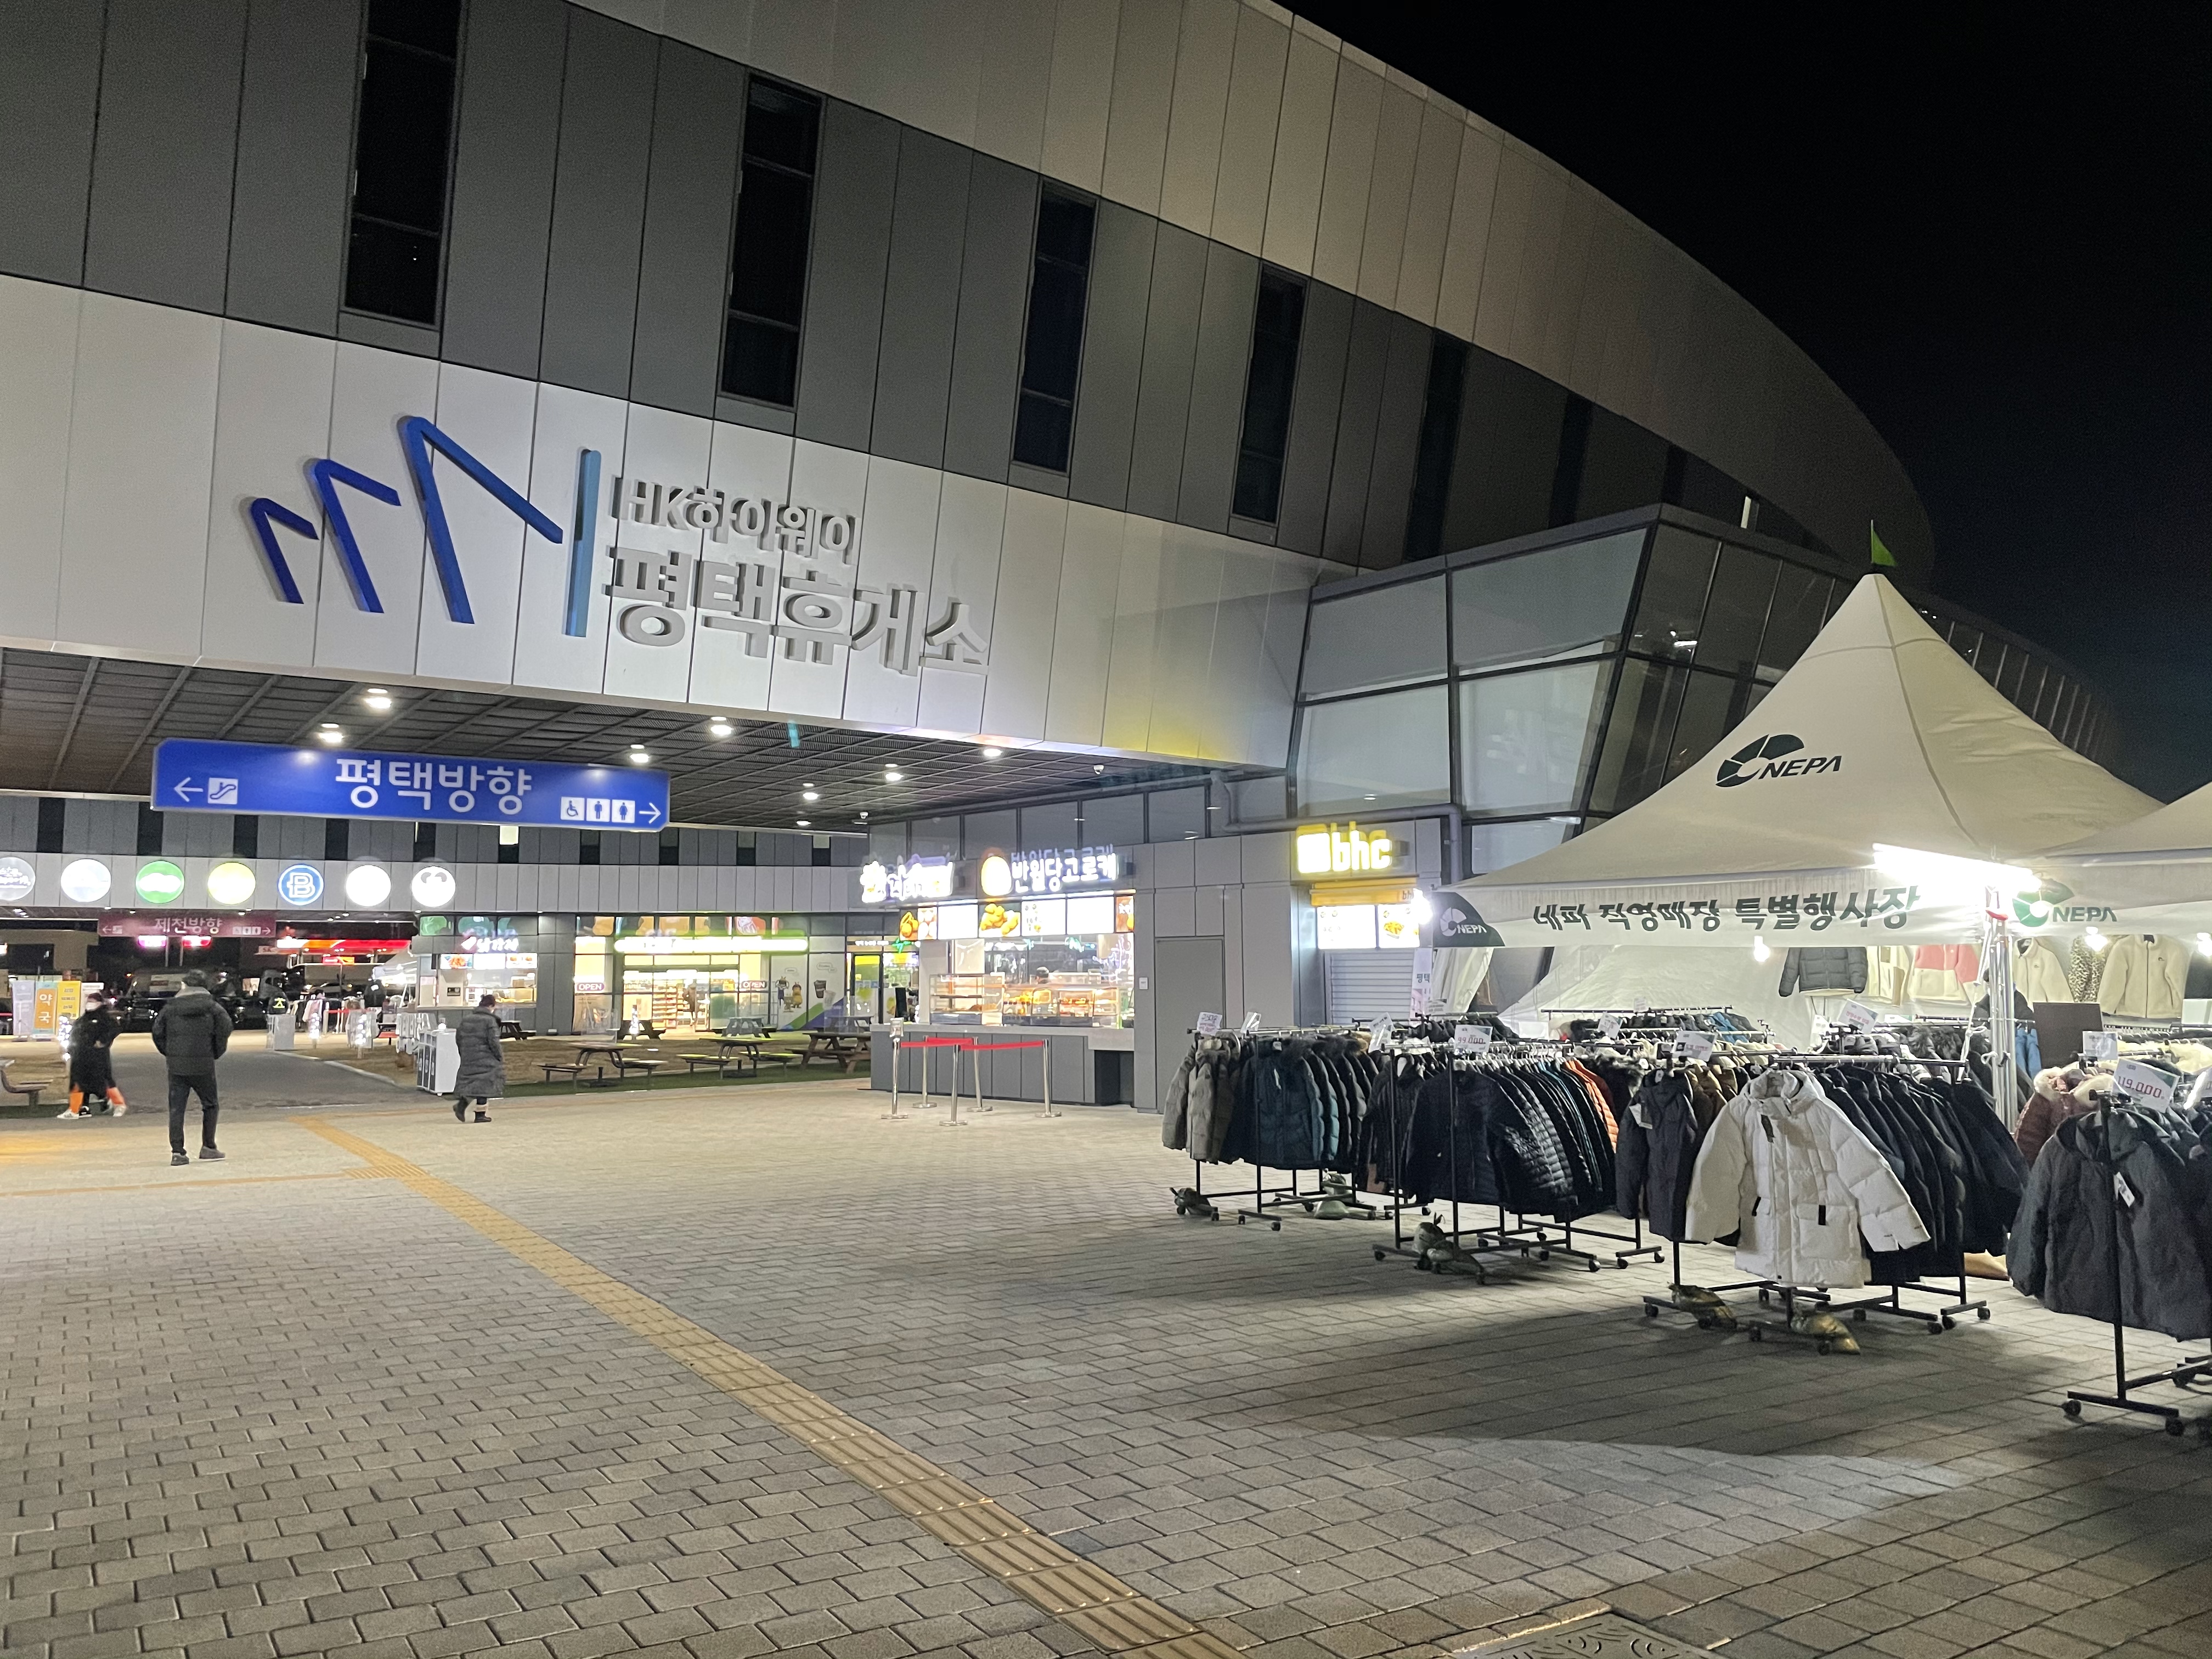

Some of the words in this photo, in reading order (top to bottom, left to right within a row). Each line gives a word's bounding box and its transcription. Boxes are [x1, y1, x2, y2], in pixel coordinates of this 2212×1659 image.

[612, 475, 861, 565] HK하이웨이
[603, 546, 989, 676] 평택휴게소
[335, 758, 532, 815] 평택방향
[1758, 755, 1842, 780] NEPA
[1331, 830, 1392, 872] bhc
[1011, 853, 1117, 894] 반월당고로케
[154, 917, 223, 934] 제천방향
[1457, 924, 1487, 934] NEPA
[1533, 904, 1591, 930] 네파
[1598, 899, 1720, 932] 직영매장
[1734, 885, 1921, 931] 특별행사장
[2052, 906, 2117, 922] NEPA
[38, 993, 53, 1024] 약국
